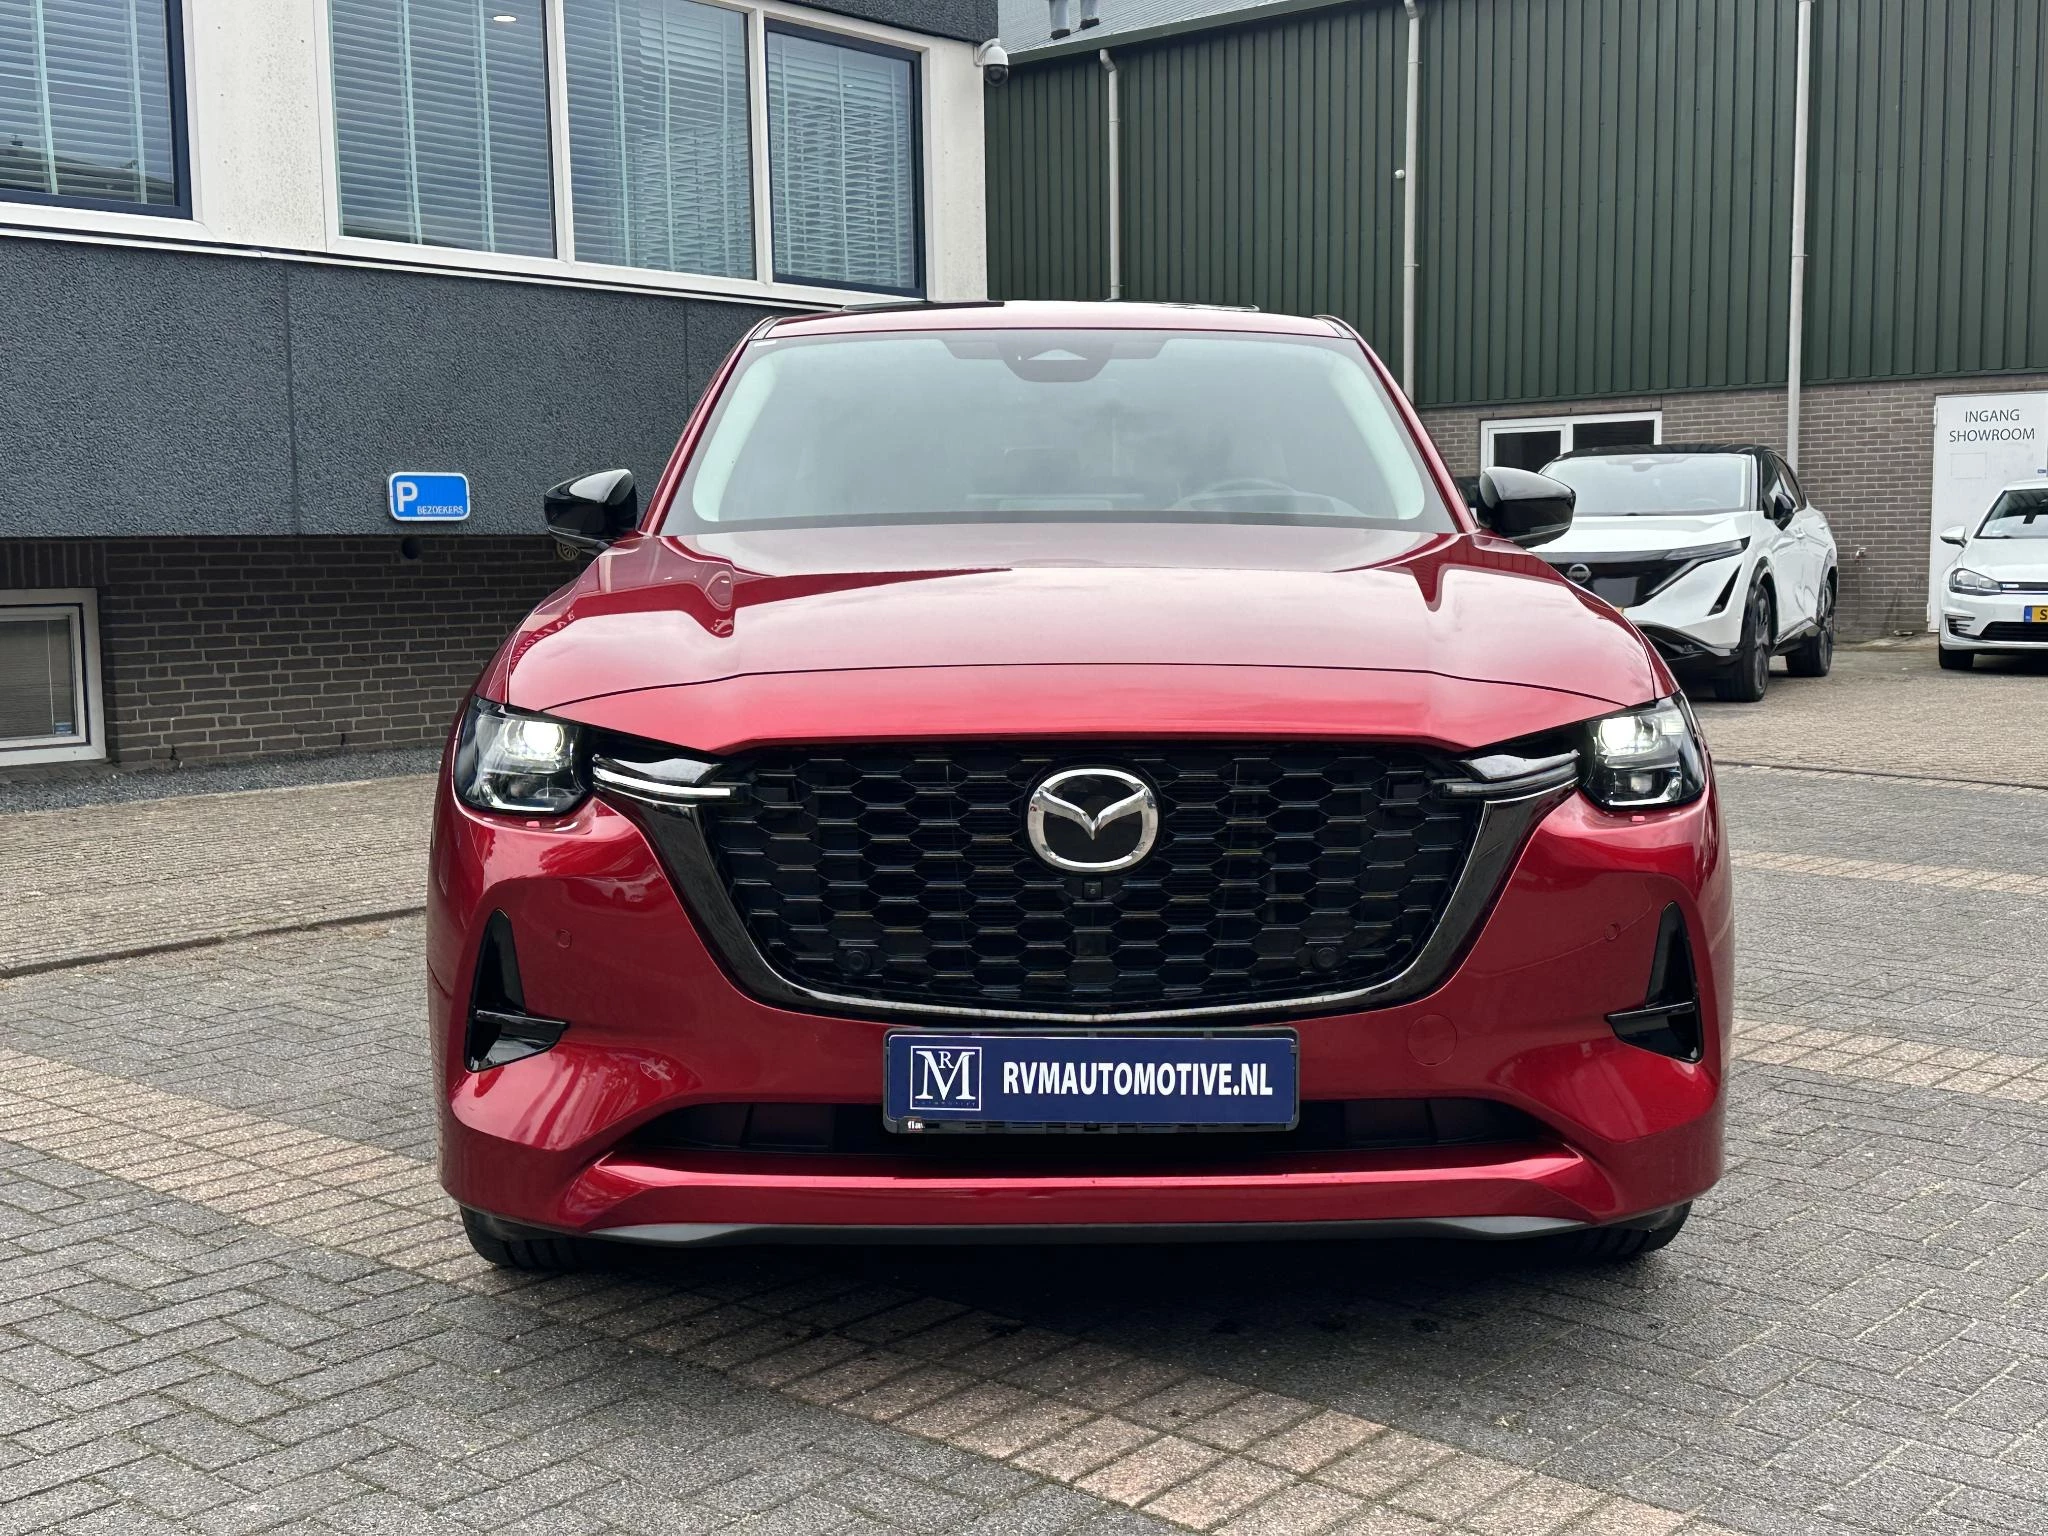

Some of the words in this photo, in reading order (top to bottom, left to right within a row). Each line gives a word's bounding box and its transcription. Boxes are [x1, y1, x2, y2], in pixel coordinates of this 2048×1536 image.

[1965, 408, 2020, 423] INGANG
[1949, 427, 2035, 443] SHOWROOM
[396, 481, 418, 512] P
[417, 505, 464, 515] BEZOEKERS
[1003, 1061, 1273, 1096] RVMAUTOMOTIVE.NL
